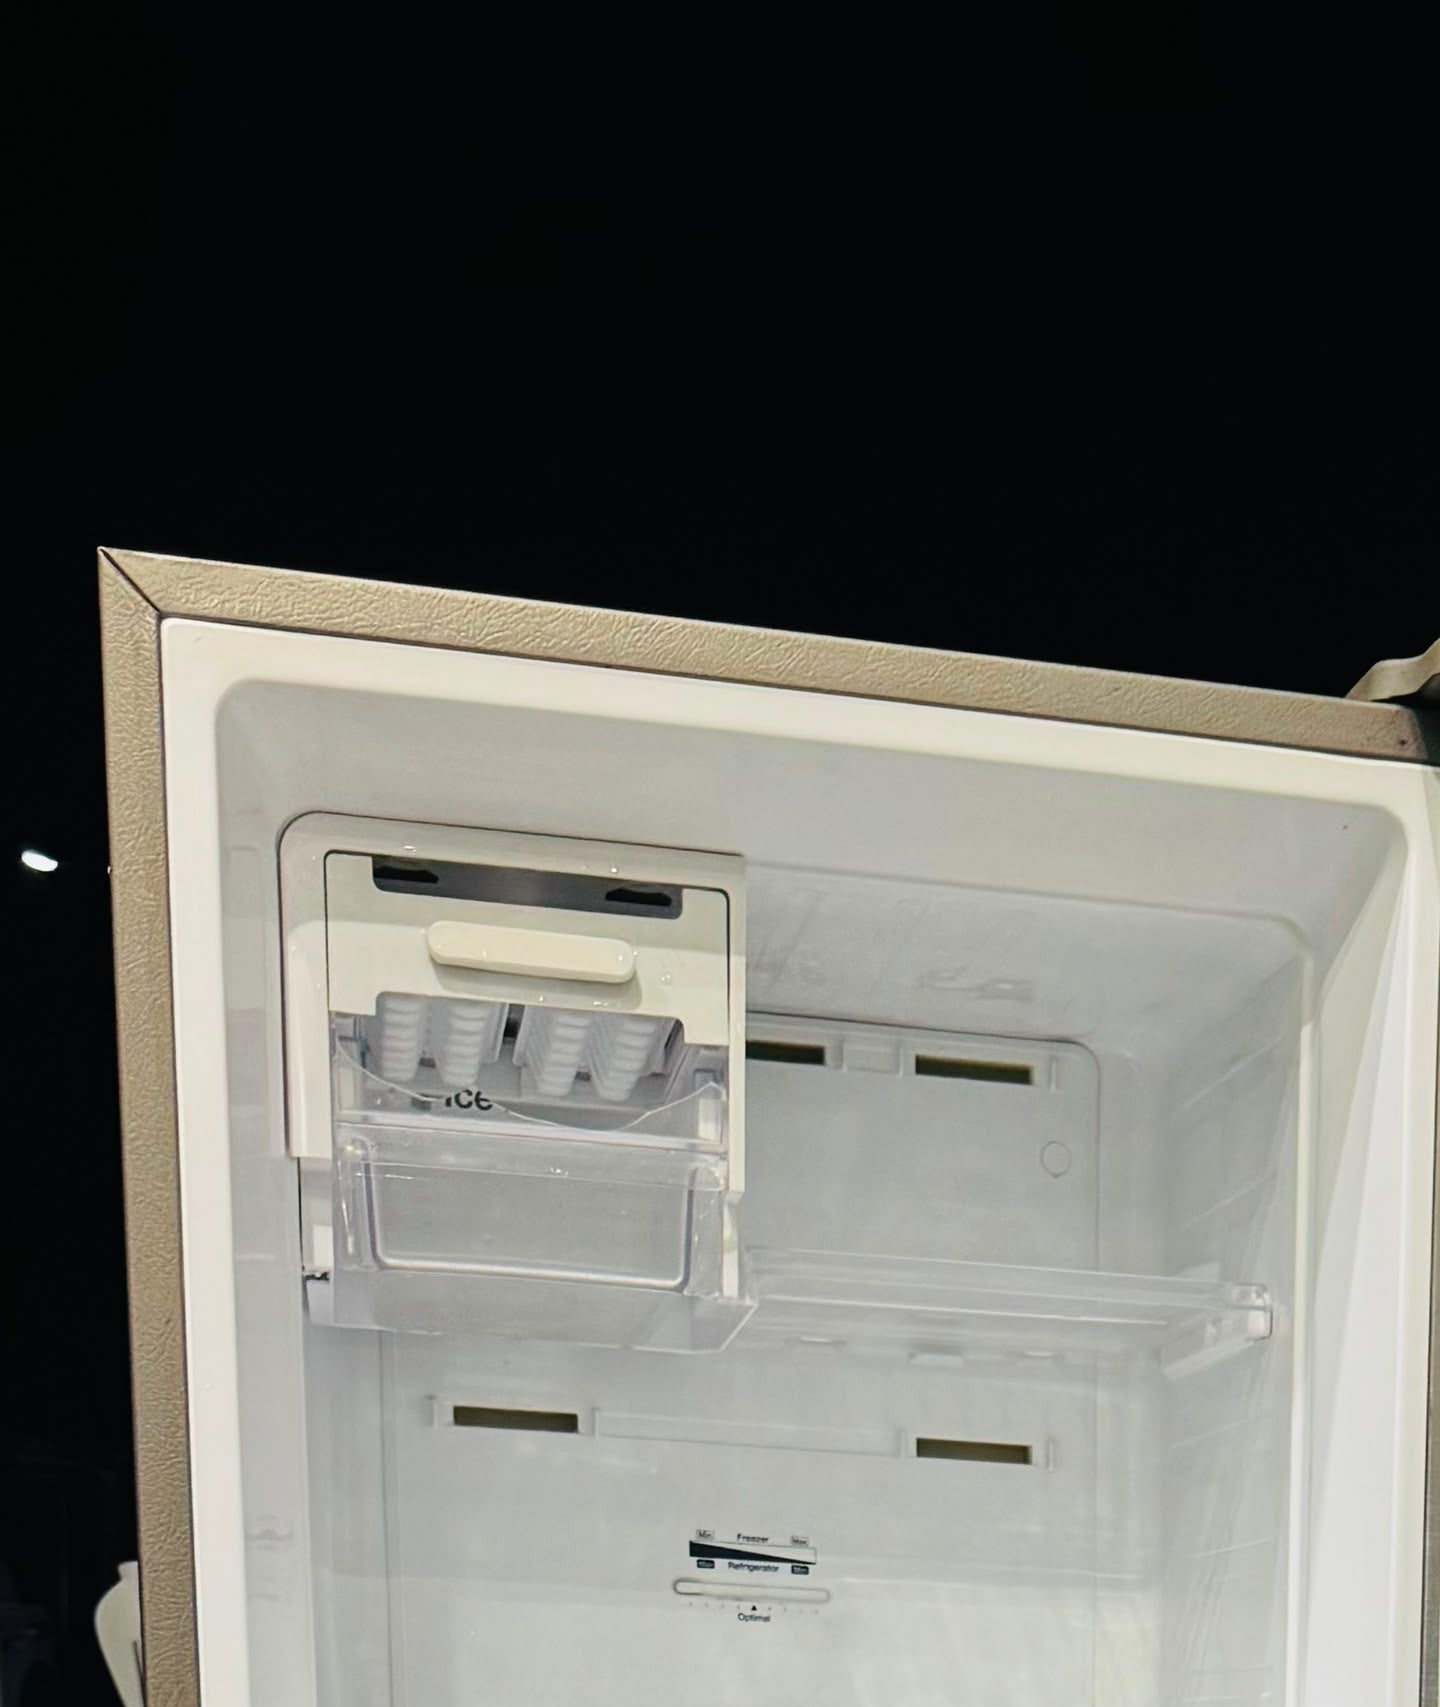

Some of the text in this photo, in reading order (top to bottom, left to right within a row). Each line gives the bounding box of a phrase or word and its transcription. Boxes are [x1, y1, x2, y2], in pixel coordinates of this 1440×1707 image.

[737, 1533, 769, 1542] Freezer
[728, 1562, 779, 1572] Refrigerator
[737, 1612, 771, 1623] Optimal
